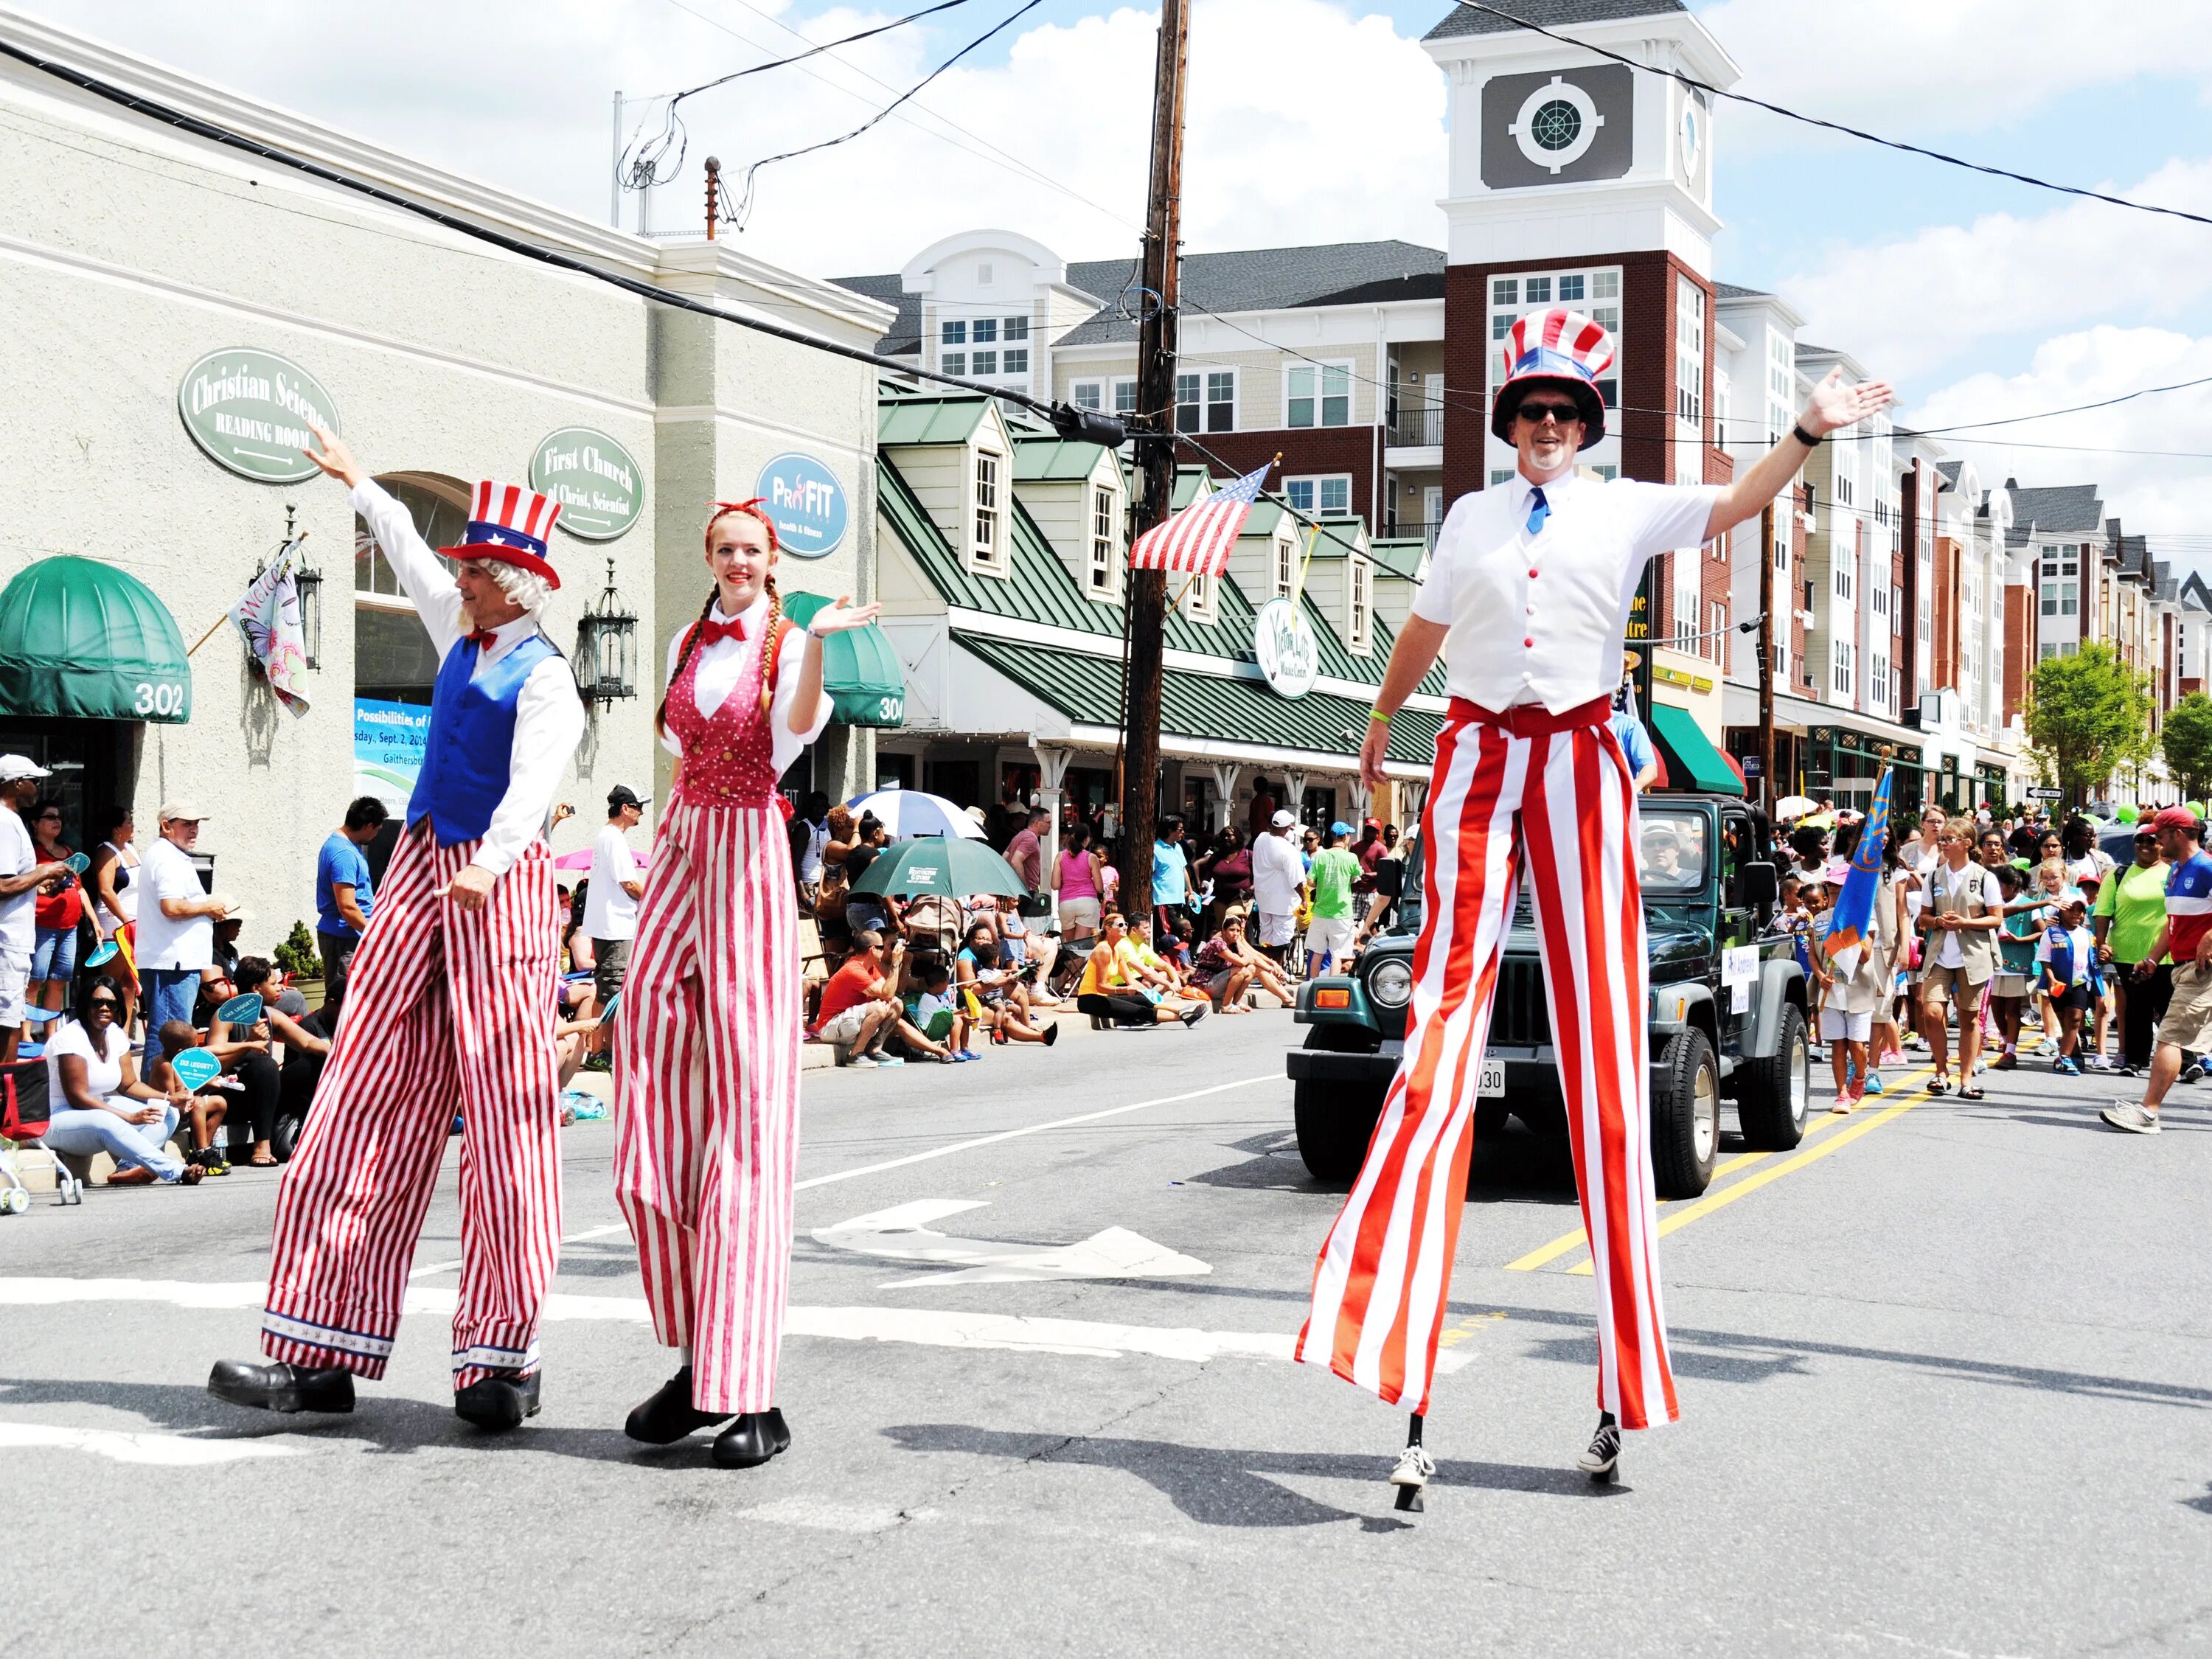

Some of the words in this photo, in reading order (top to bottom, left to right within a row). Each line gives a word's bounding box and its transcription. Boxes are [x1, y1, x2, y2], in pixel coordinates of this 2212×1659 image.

[192, 364, 271, 416] Christian
[275, 371, 331, 431] Science
[215, 412, 272, 443] READING
[275, 424, 310, 450] ROOM
[544, 447, 579, 476] First
[582, 446, 633, 495] Church
[548, 482, 557, 501] of
[559, 484, 591, 510] Christ,
[592, 491, 630, 516] Scientist
[135, 682, 184, 716] 302
[357, 709, 414, 727] Possibilities
[416, 714, 427, 727] of
[379, 732, 398, 747] Sept.
[400, 734, 408, 746] 2,
[189, 1061, 215, 1070] LEGGETT
